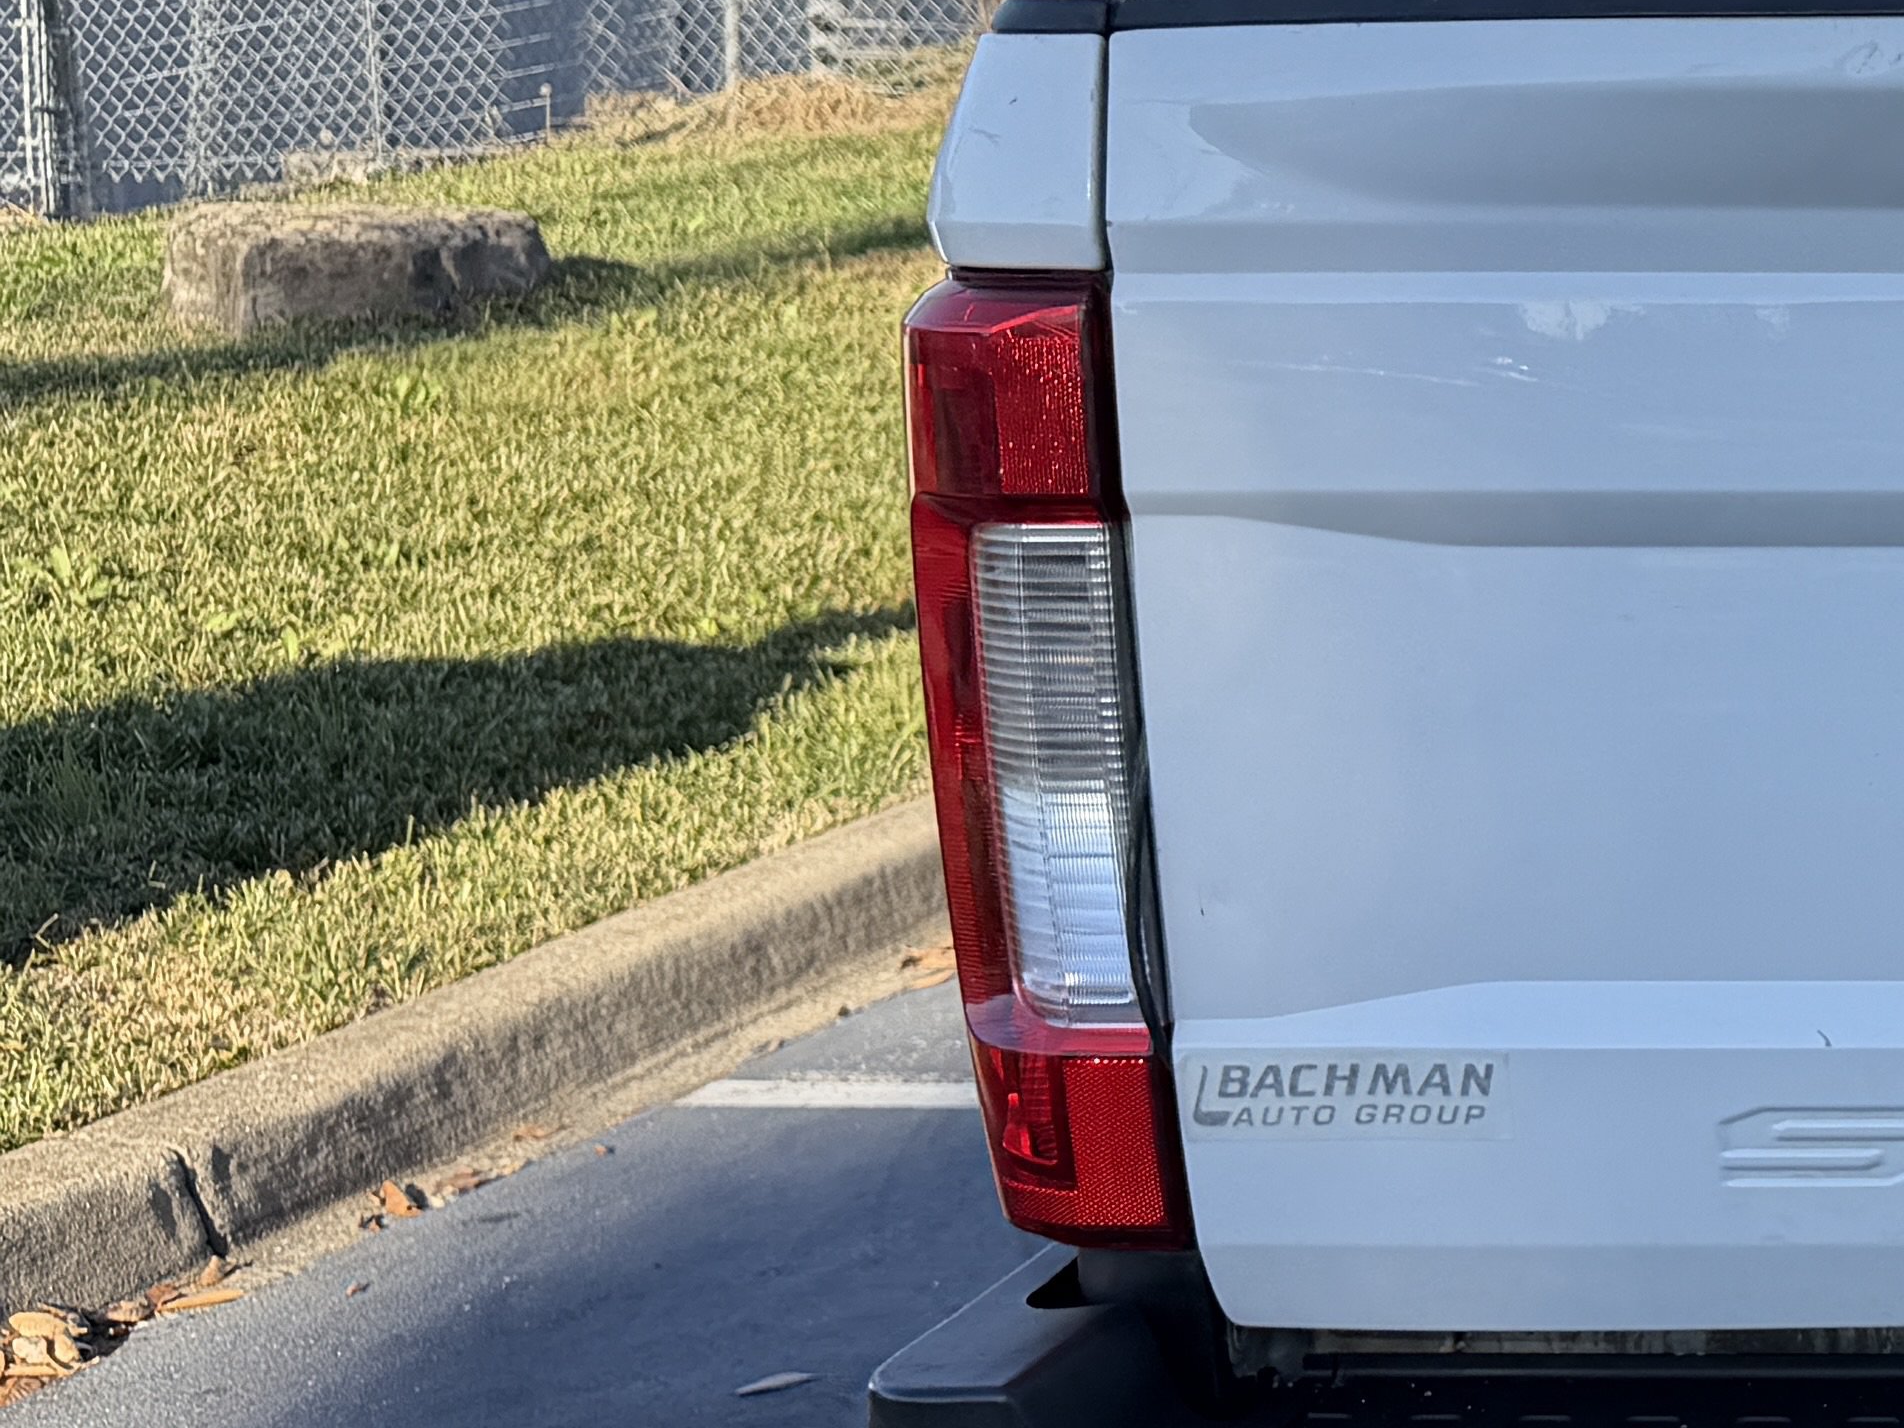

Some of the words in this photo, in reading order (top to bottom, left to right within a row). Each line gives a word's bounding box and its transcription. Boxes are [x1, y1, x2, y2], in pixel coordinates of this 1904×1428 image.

[1217, 1063, 1495, 1099] BACHMAN
[1232, 1105, 1336, 1127] AUTO
[1354, 1103, 1487, 1125] GROUP
